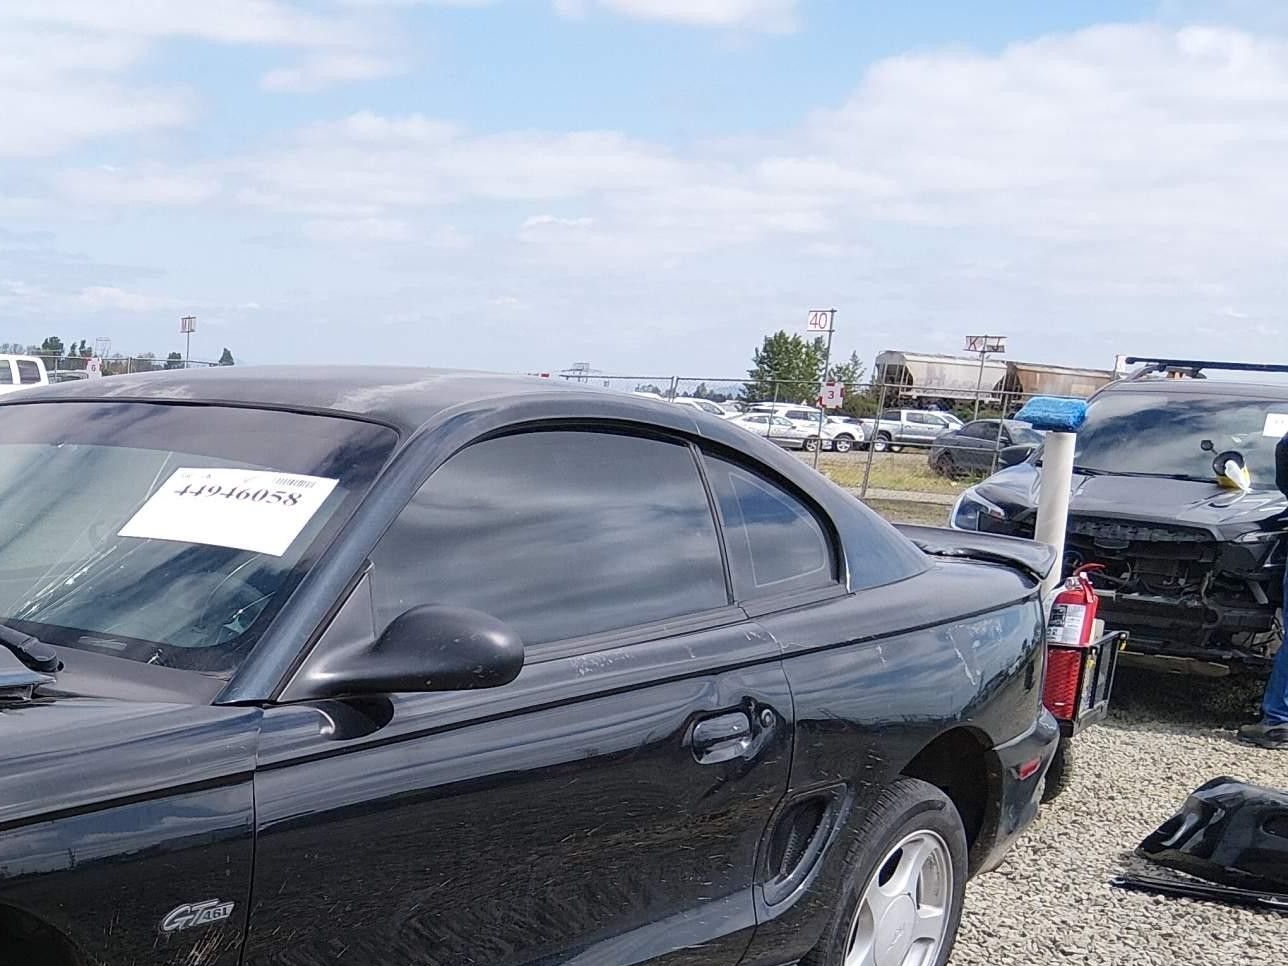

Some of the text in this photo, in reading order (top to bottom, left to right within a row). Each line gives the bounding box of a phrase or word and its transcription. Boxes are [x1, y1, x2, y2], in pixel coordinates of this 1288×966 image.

[809, 313, 828, 329] 40
[968, 336, 979, 351] K
[827, 391, 835, 400] 3
[174, 483, 304, 506] 44946058
[162, 898, 220, 931] GT
